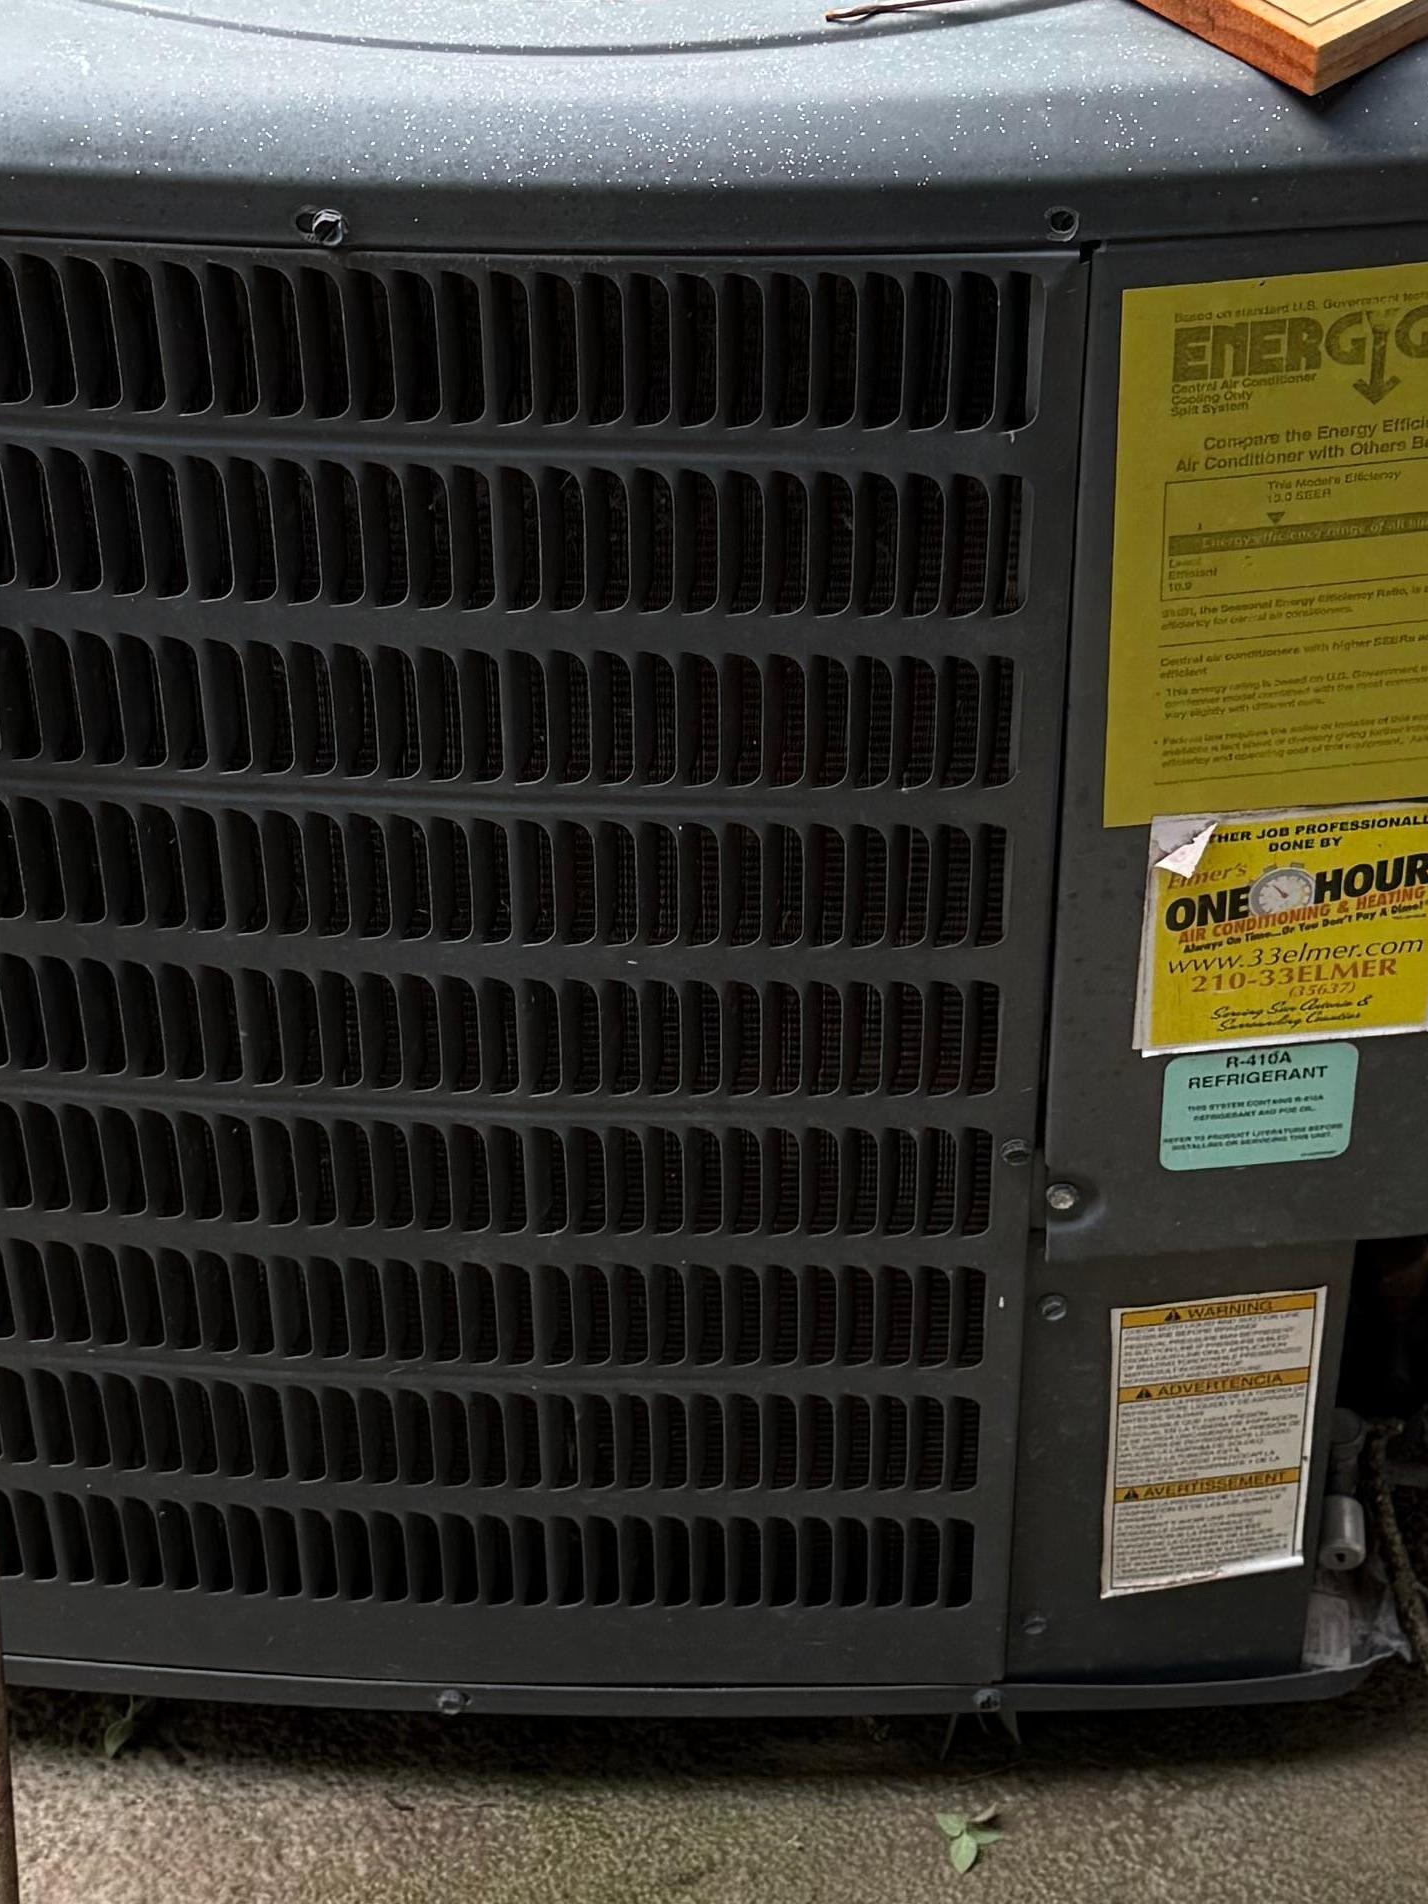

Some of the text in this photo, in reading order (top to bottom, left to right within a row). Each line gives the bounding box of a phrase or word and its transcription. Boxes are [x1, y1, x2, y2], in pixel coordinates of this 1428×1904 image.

[1171, 370, 1316, 395] Central Air Conditioner
[1170, 389, 1253, 407] Cooling Only
[1170, 400, 1249, 418] Split System
[1203, 430, 1279, 454] Compare
[1285, 428, 1312, 443] the
[1317, 420, 1377, 442] Energy
[1175, 458, 1199, 473] Air
[1204, 448, 1303, 470] Conditioner
[1308, 444, 1344, 459] with
[1350, 436, 1407, 456] Others
[1267, 479, 1293, 491] This
[1209, 831, 1252, 843] THER
[1256, 827, 1289, 840] JOB
[1268, 836, 1343, 852] DONE BY
[1165, 885, 1251, 931] ONE
[1178, 887, 1425, 944] AIR CONDITIONING & HEATING
[1183, 939, 1223, 953] Always
[1227, 934, 1241, 945] On
[1299, 922, 1318, 932] You
[1322, 915, 1352, 928] Don't
[1356, 911, 1376, 922] Pay
[1380, 909, 1387, 917] A
[1169, 939, 1423, 974] www.33elmer.com
[1191, 958, 1397, 993] 210-33ELMER
[1288, 982, 1356, 998] (35637)
[1267, 1001, 1296, 1014] San
[1225, 1050, 1292, 1068] R-410A
[1188, 1065, 1328, 1089] REFRIGERANT
[1187, 1301, 1272, 1318] WARNING
[1157, 1373, 1283, 1396] ADVERTENCIA
[1144, 1472, 1286, 1498] AVERTISSEMENT
